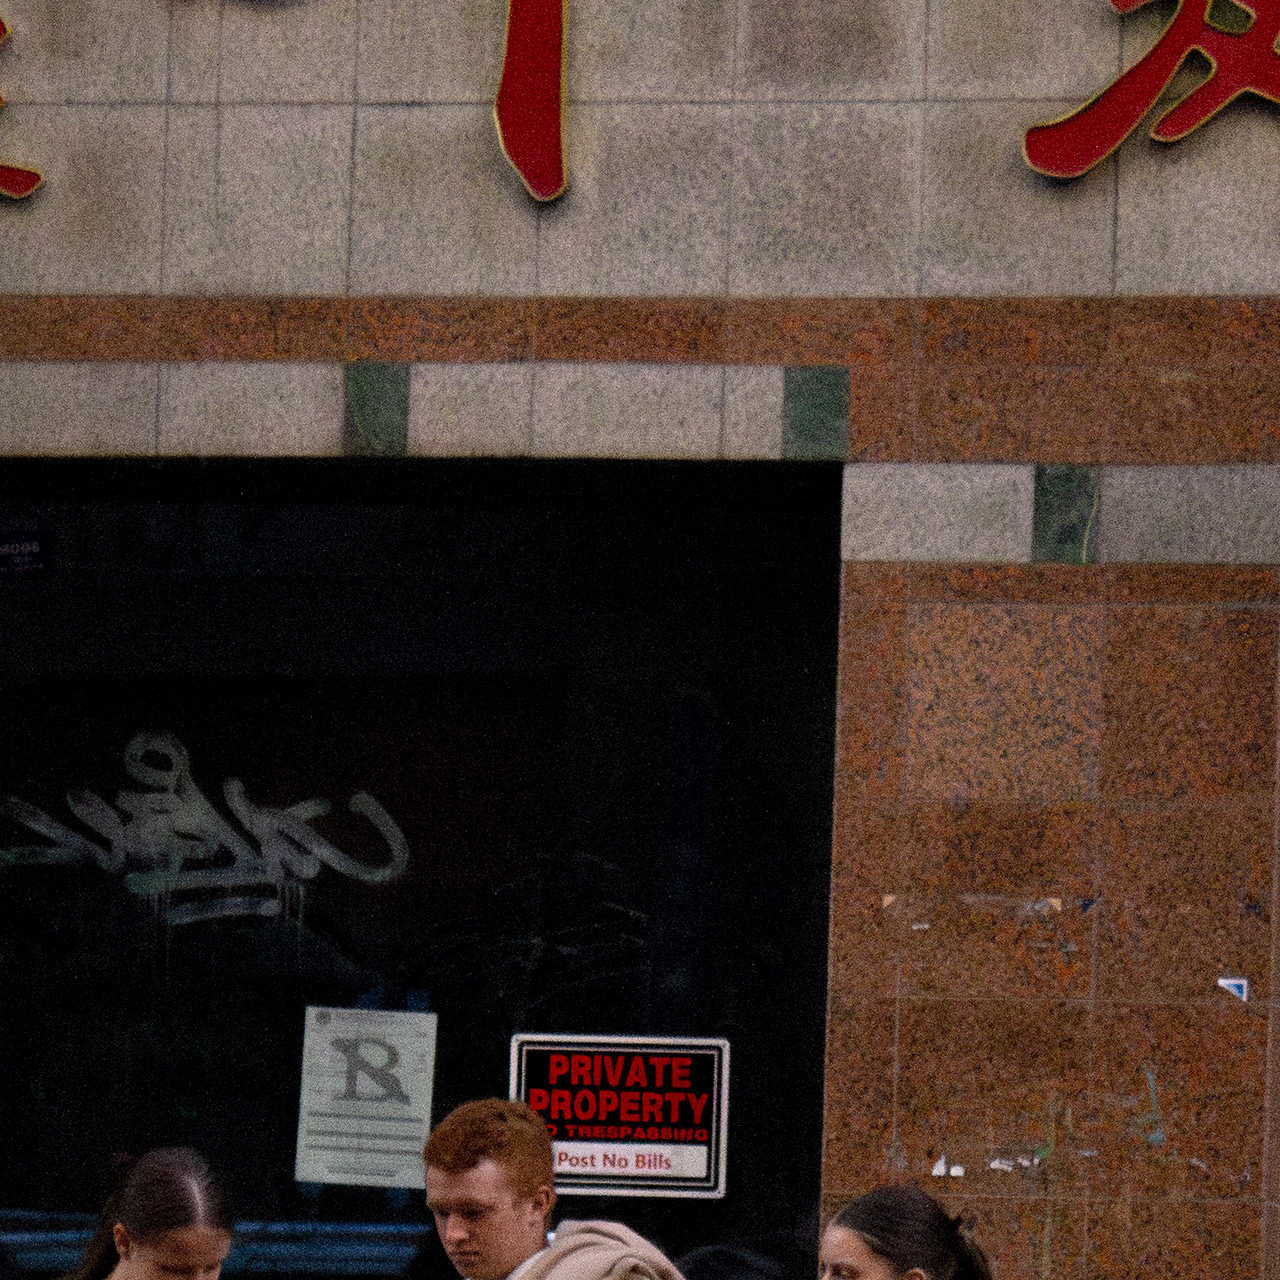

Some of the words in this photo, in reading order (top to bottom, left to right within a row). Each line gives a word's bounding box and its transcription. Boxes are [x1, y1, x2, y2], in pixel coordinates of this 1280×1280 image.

[549, 1054, 692, 1089] PRIVATE
[529, 1088, 709, 1124] PROPERTY
[564, 1125, 709, 1141] TRESPASSING
[557, 1151, 596, 1168] Post
[602, 1153, 629, 1168] No
[634, 1153, 672, 1170] Bills
